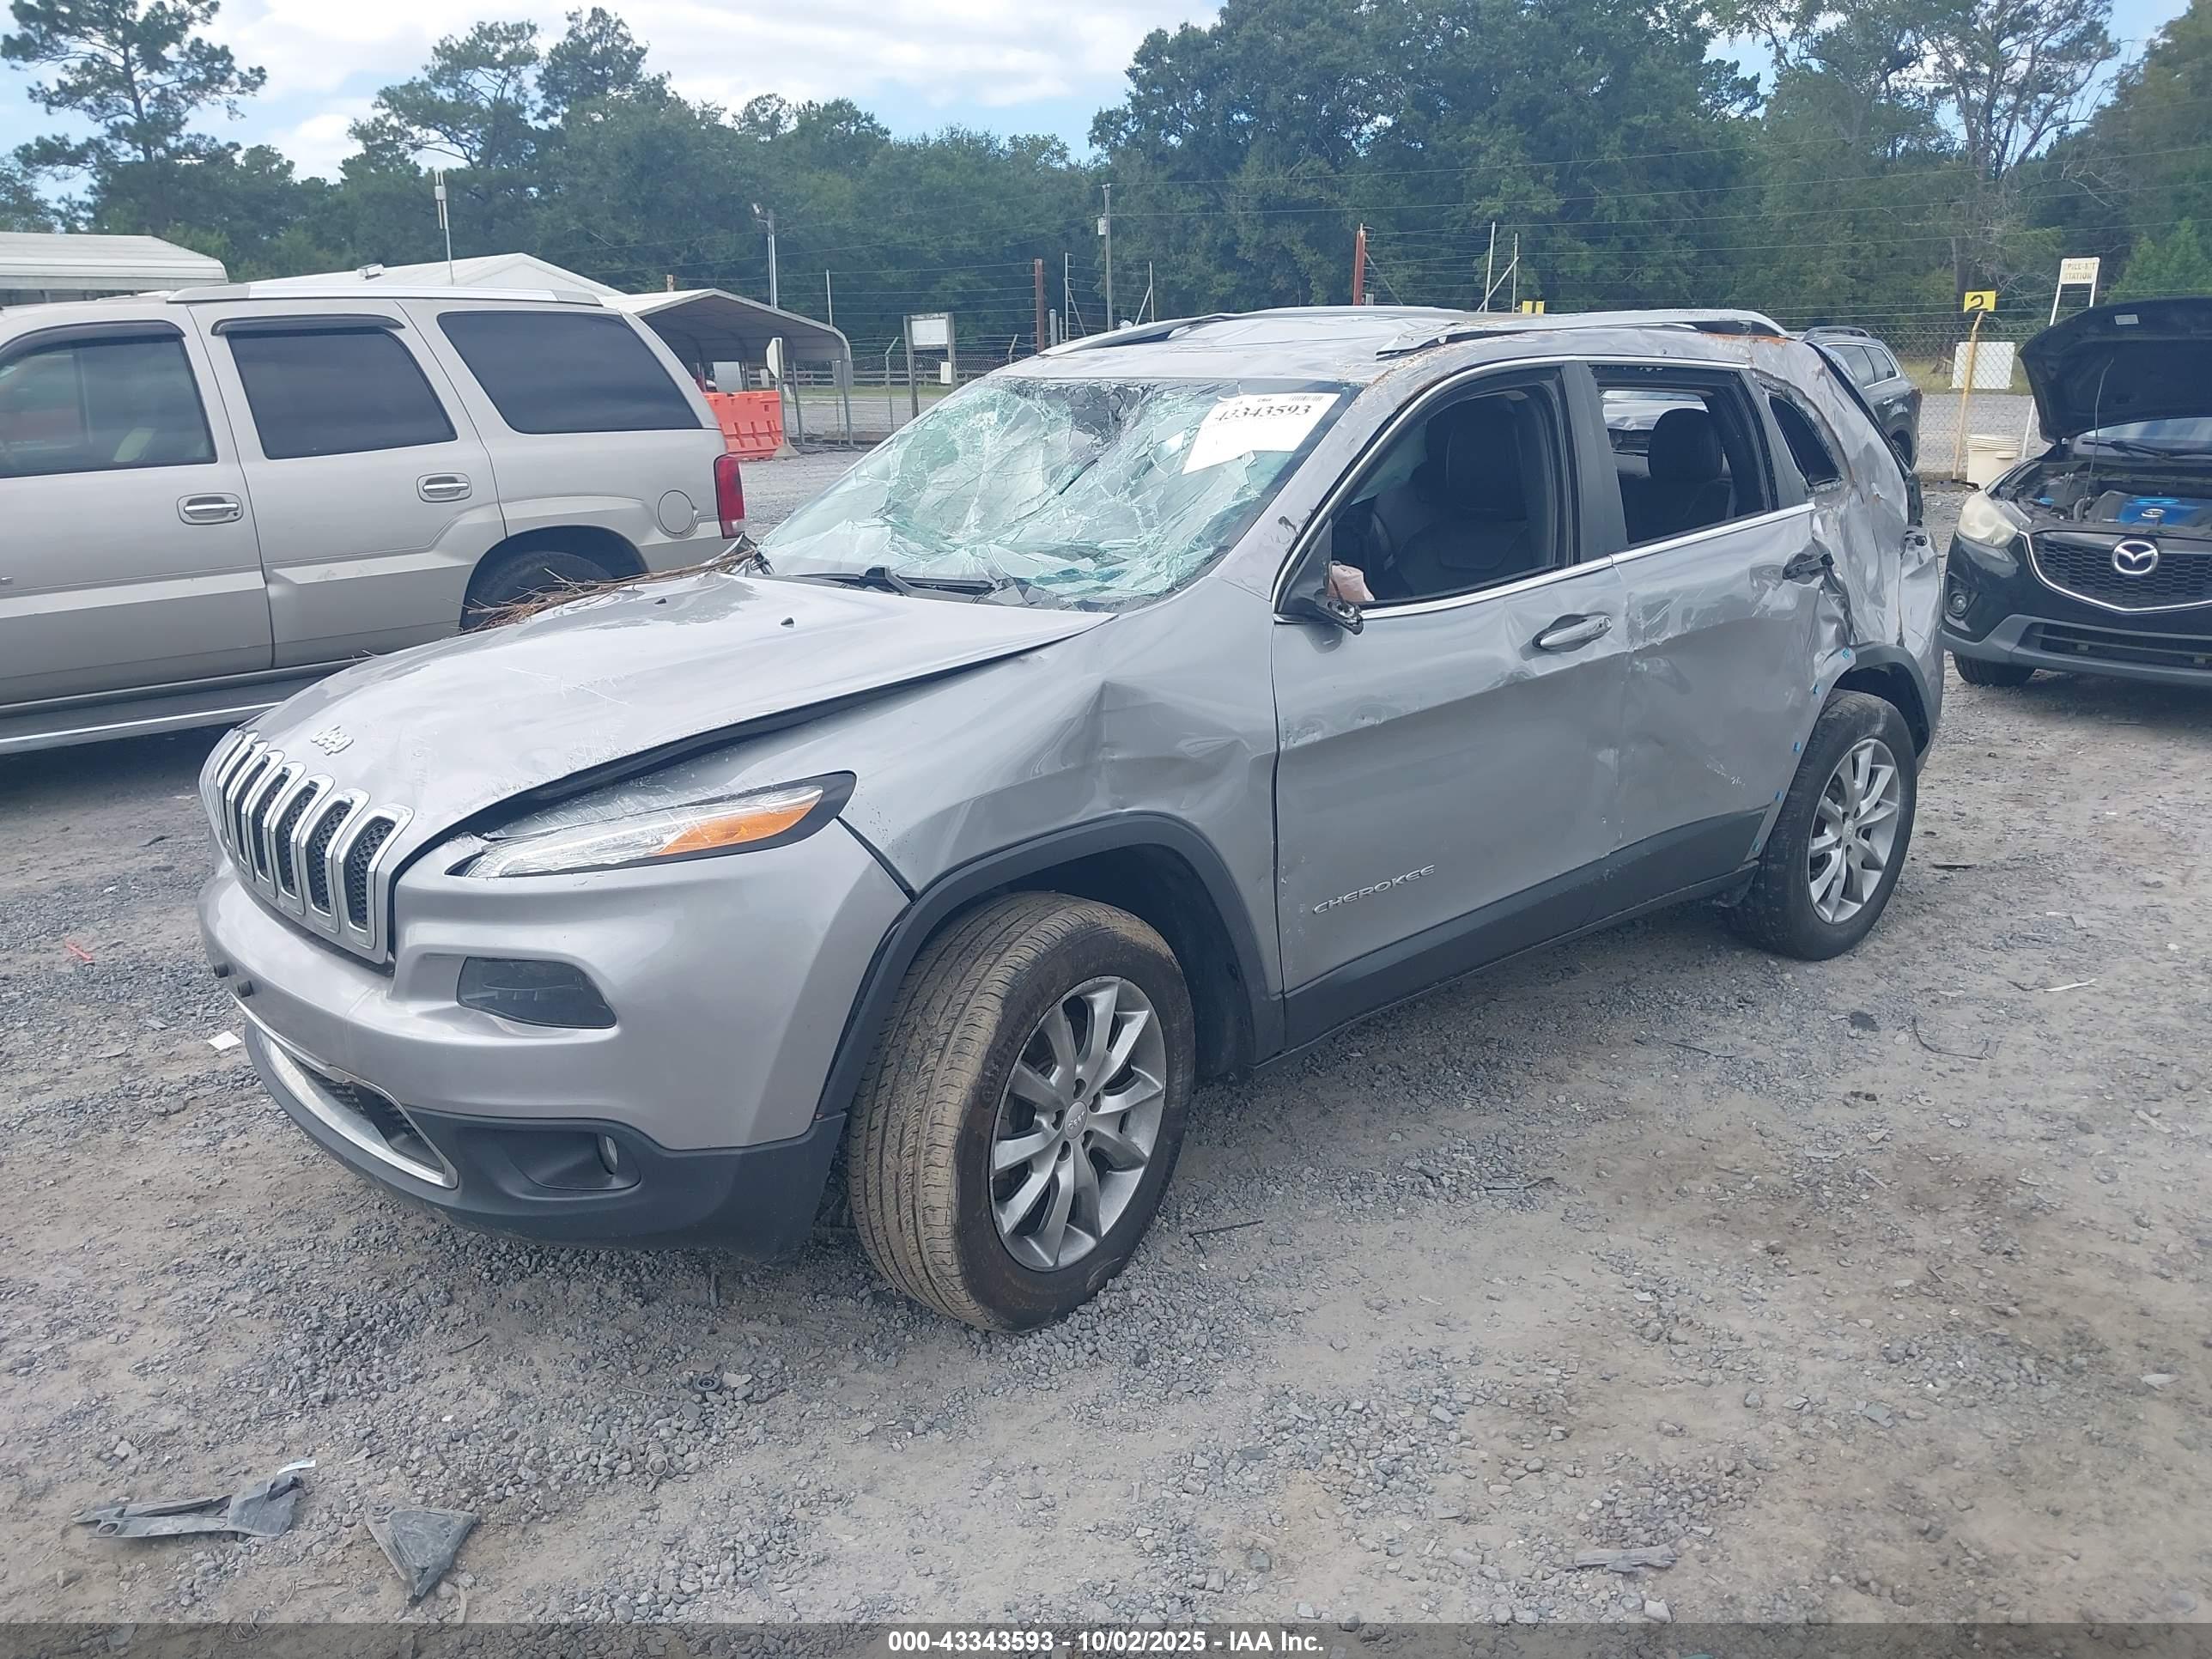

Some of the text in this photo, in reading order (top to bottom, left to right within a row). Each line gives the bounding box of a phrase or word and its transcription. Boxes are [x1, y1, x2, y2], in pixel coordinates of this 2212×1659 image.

[1966, 294, 1989, 313] 2
[1214, 404, 1312, 422] 43343593
[1313, 864, 1437, 915] CHEROKEE
